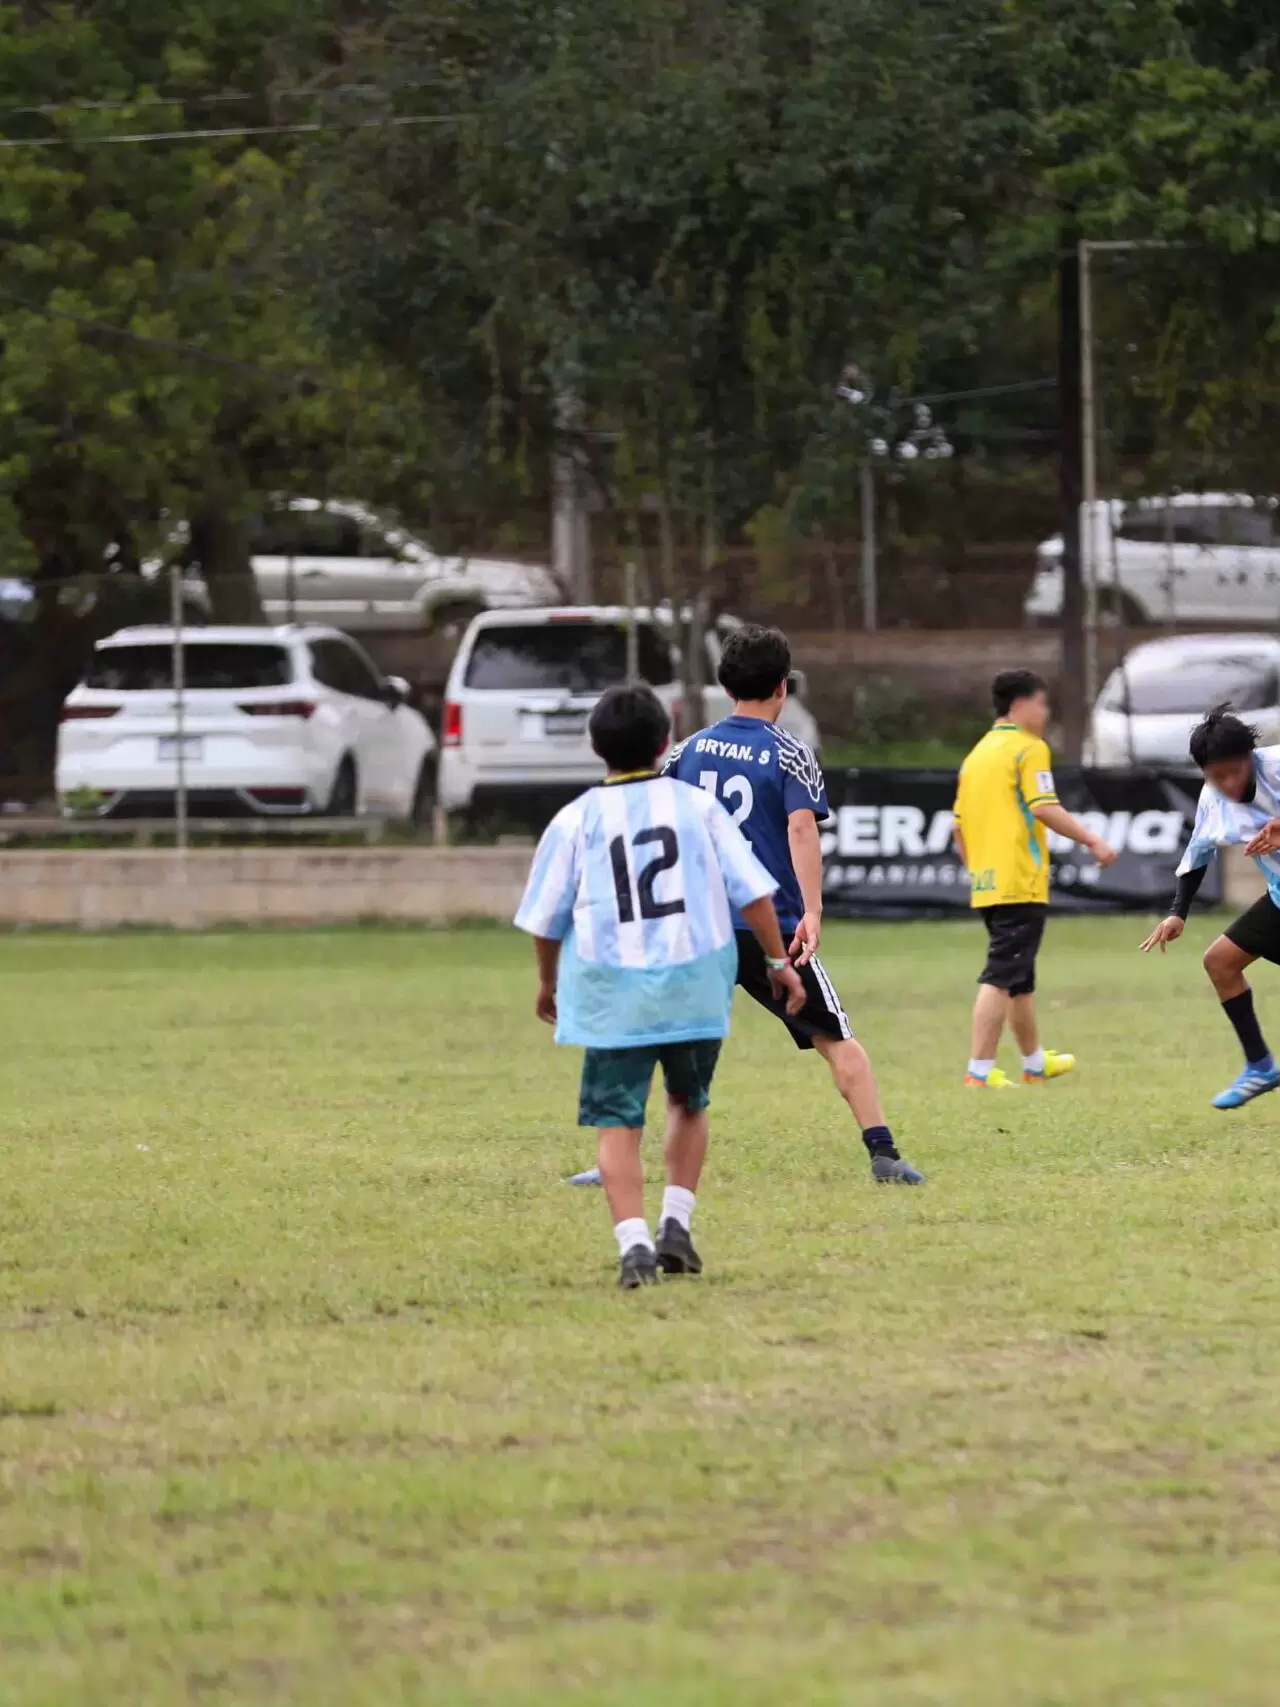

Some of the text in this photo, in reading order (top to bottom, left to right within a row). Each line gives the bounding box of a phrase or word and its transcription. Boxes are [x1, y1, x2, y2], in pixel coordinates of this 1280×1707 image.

[695, 738, 771, 765] BRYAN. S
[609, 825, 686, 923] 12
